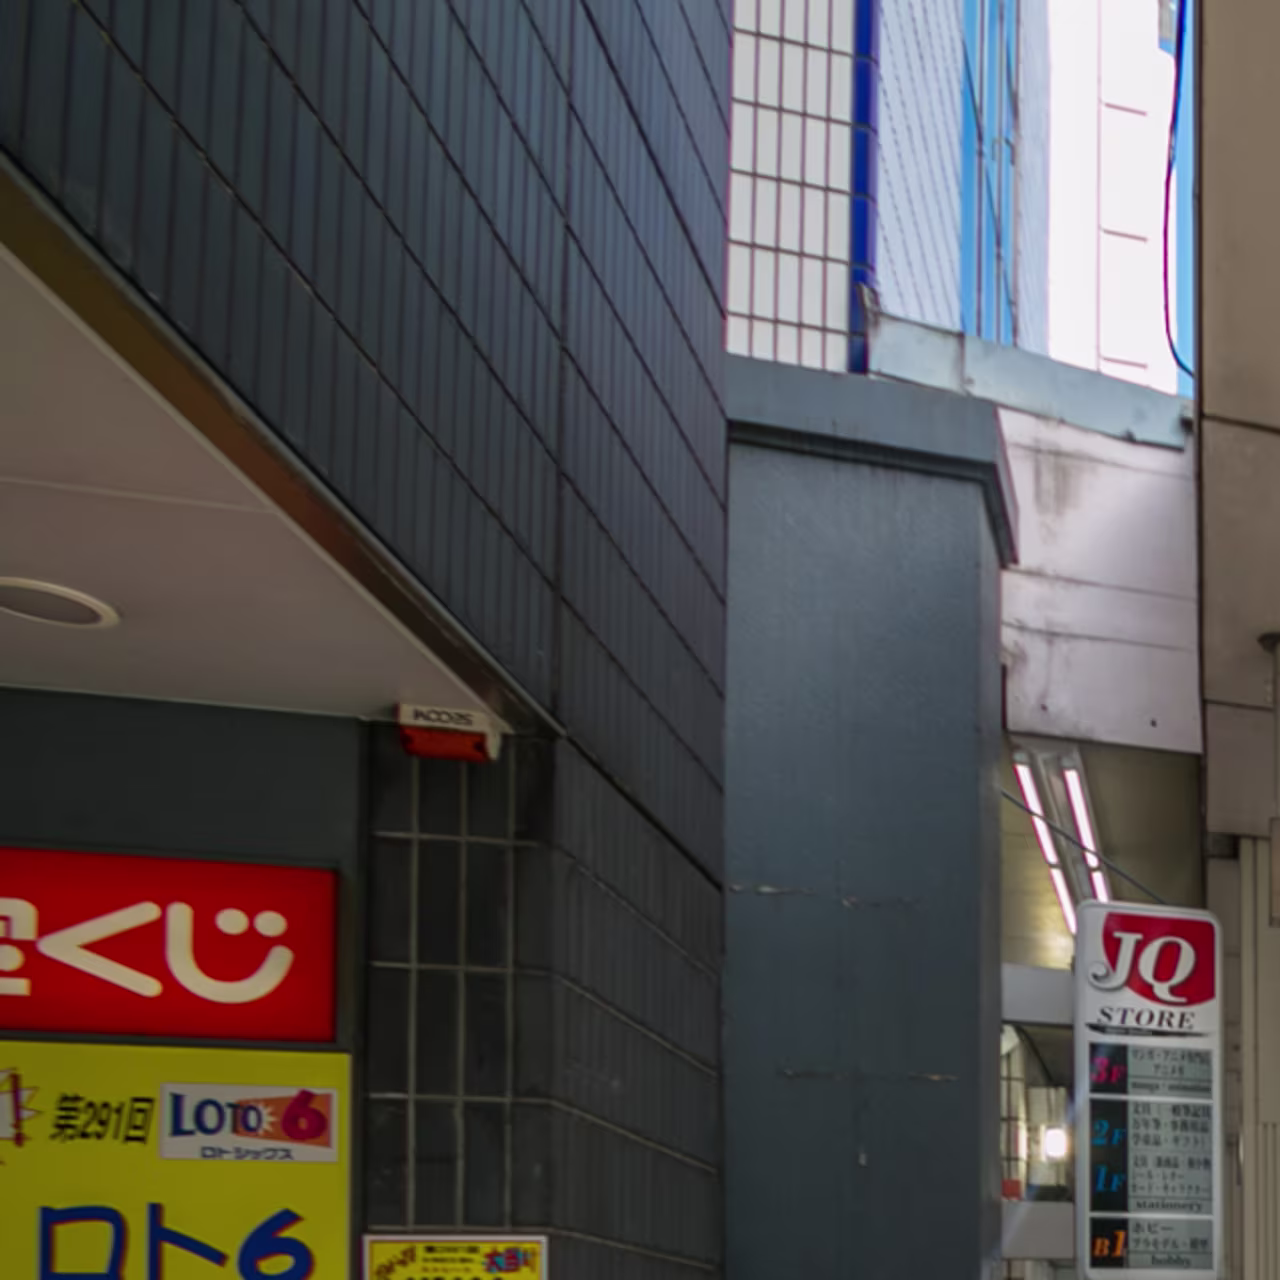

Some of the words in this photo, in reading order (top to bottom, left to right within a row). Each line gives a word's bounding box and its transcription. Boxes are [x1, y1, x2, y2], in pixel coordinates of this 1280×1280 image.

[0, 897, 295, 1004] くじ
[1087, 930, 1197, 1003] JQ
[1096, 1006, 1196, 1030] STORE
[1090, 1056, 1128, 1084] 3F
[49, 1092, 156, 1145] 第291回
[168, 1091, 264, 1138] LOTO
[281, 1089, 328, 1141] 6
[1090, 1119, 1127, 1147] 2F
[1094, 1163, 1127, 1193] 1F
[1136, 1200, 1203, 1213] stationery
[1132, 1221, 1175, 1235] ホビー
[1090, 1228, 1128, 1258] B1
[1151, 1254, 1191, 1268] hobby
